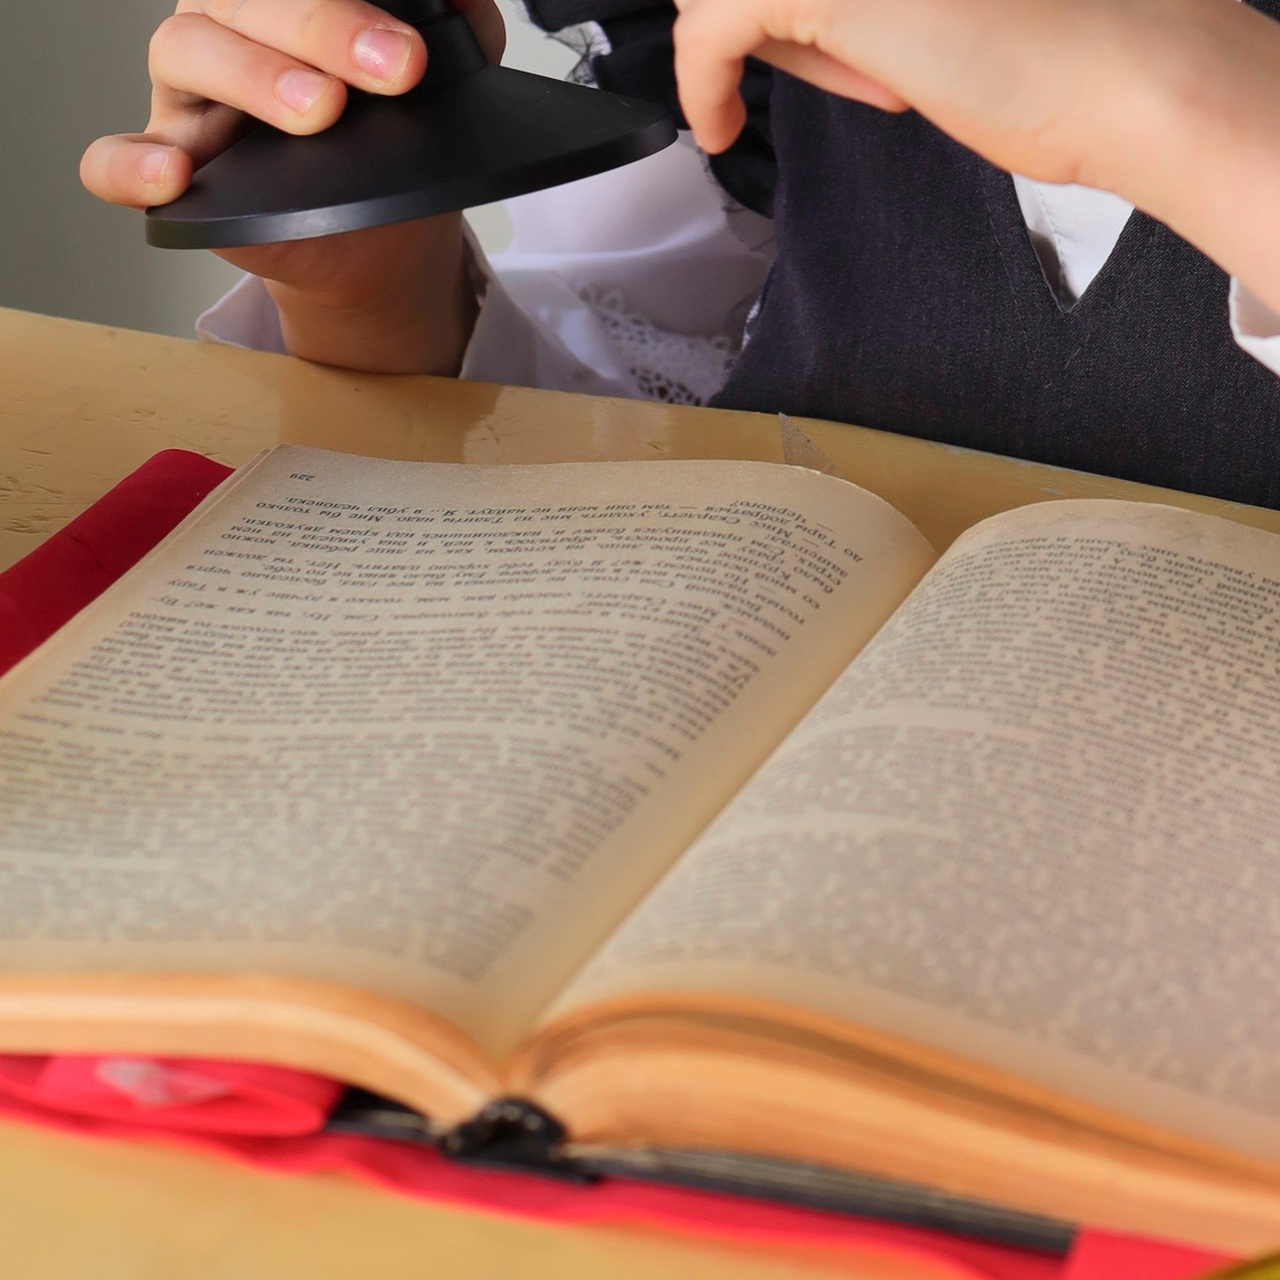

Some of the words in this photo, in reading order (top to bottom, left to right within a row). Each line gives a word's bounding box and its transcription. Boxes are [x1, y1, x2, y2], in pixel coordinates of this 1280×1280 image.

[290, 473, 315, 482] 229
[255, 502, 312, 514] только
[285, 497, 360, 511] человека.
[318, 510, 342, 519] бы
[367, 506, 410, 515] убил
[466, 507, 526, 515] найдут.
[580, 510, 650, 519] уходить
[705, 506, 791, 525] добраться
[730, 500, 806, 524] Черного?
[349, 513, 384, 522] Мне
[394, 515, 435, 523] надо.
[658, 511, 741, 525] Скарлетт,
[230, 525, 263, 534] нем
[242, 517, 325, 532] двуколки,
[749, 521, 793, 538] Мисс
[328, 528, 383, 537] краем
[422, 531, 542, 539] наклонившись
[571, 527, 626, 535] ближе
[633, 527, 743, 542] придвинулся
[795, 524, 836, 549] Тары
[221, 533, 276, 545] можно
[301, 534, 371, 545] увидела
[504, 536, 598, 545] обратилось
[611, 534, 689, 544] прочесть,
[699, 540, 726, 548] все
[287, 540, 358, 553] ребенка,
[484, 546, 556, 554] котором,
[650, 545, 708, 555] черное
[751, 540, 785, 556] Сэм
[202, 549, 268, 561] должен
[738, 546, 785, 565] сразу
[765, 534, 848, 578] зашептал:
[844, 548, 864, 563] до
[305, 559, 341, 570] Нет,
[352, 563, 421, 571] платить.
[428, 563, 489, 571] хорошо
[499, 562, 534, 570] тебе
[543, 559, 584, 567] буду
[611, 559, 644, 567] же?
[653, 561, 716, 574] почему
[673, 555, 749, 574] остаться.
[718, 552, 791, 581] Крупное
[1187, 556, 1254, 579] увидеть
[186, 565, 231, 575] чертя
[262, 564, 301, 574] себе.
[496, 568, 558, 577] дороги.
[629, 569, 668, 577] ноги
[795, 554, 841, 586] страх.
[241, 571, 327, 587] бесцельно
[452, 571, 486, 579] Ему
[578, 575, 630, 583] стоял,
[724, 572, 749, 585] Но
[793, 566, 834, 594] было
[167, 580, 207, 592] Тару
[339, 579, 378, 588] глаз,
[454, 577, 536, 586] поднимая
[639, 578, 674, 589] Сэм
[674, 573, 748, 595] пальцем
[755, 572, 797, 595] мной
[265, 592, 324, 602] лучше
[503, 592, 572, 602] спасибо
[582, 592, 667, 606] Скарлетт,
[685, 584, 762, 613] Большой
[802, 595, 820, 610] со
[226, 606, 257, 614] как
[676, 601, 720, 618] Мисс
